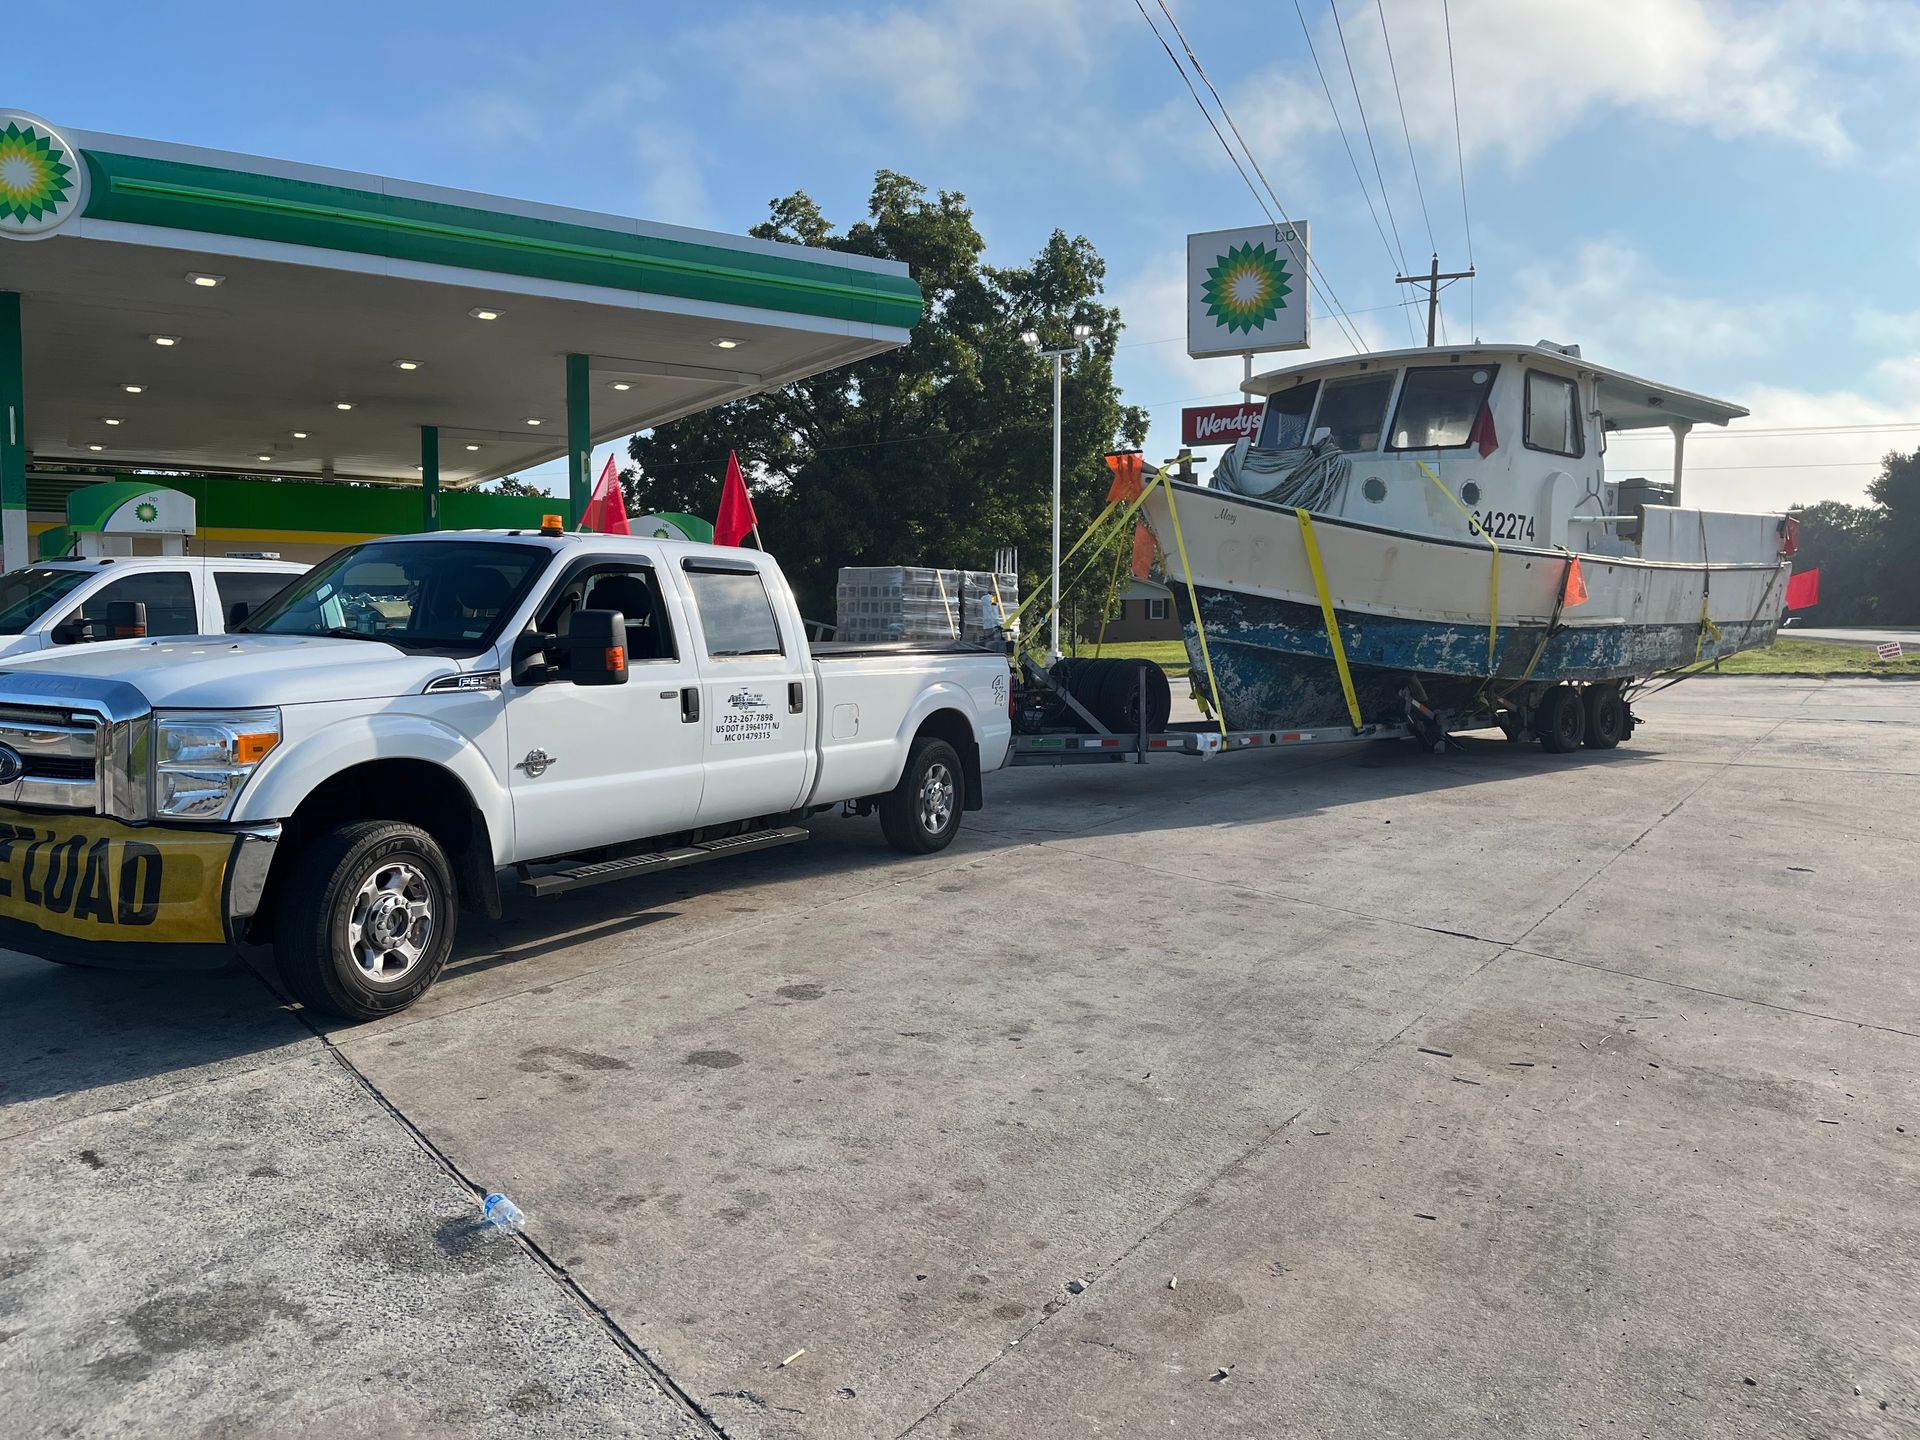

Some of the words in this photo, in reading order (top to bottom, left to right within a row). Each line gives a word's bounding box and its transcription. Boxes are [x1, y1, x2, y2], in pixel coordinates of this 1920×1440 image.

[1275, 228, 1296, 243] bp
[1196, 408, 1262, 438] Wendy's
[1468, 510, 1535, 542] 642274
[723, 714, 774, 723] 732-267-7898
[716, 725, 725, 733] US
[726, 724, 739, 732] DOT
[745, 722, 771, 731] 3964171
[772, 722, 780, 730] NJ
[724, 733, 736, 742] MC
[737, 732, 771, 740] 01479315
[23, 827, 163, 926] LOAD
